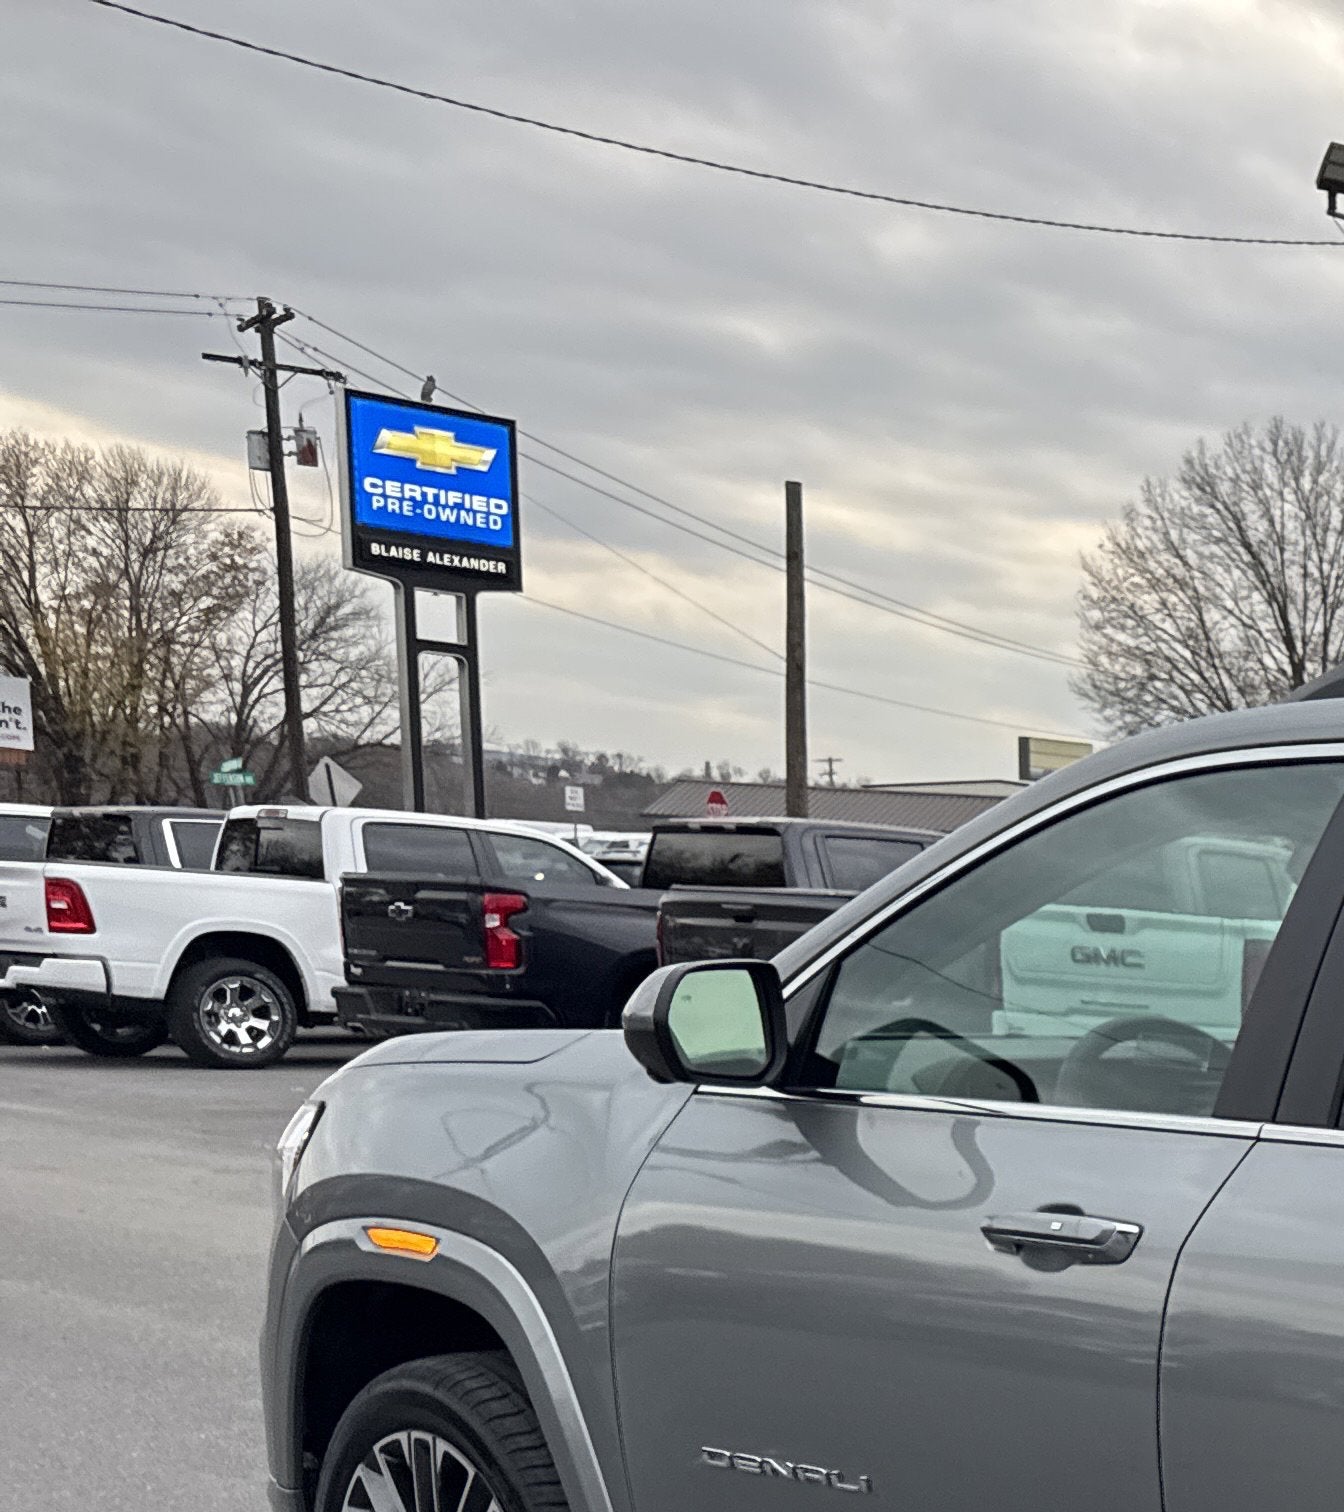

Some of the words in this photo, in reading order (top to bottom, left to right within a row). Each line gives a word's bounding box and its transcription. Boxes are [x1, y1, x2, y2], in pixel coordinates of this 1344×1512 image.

[363, 476, 509, 515] CERTIFIED
[372, 495, 503, 531] PRE-OWNED
[370, 542, 422, 562] BLAISE
[426, 551, 507, 574] ALEXANDER
[0, 702, 23, 717] he
[1071, 945, 1145, 970] GMC
[701, 1446, 874, 1494] DENALI
